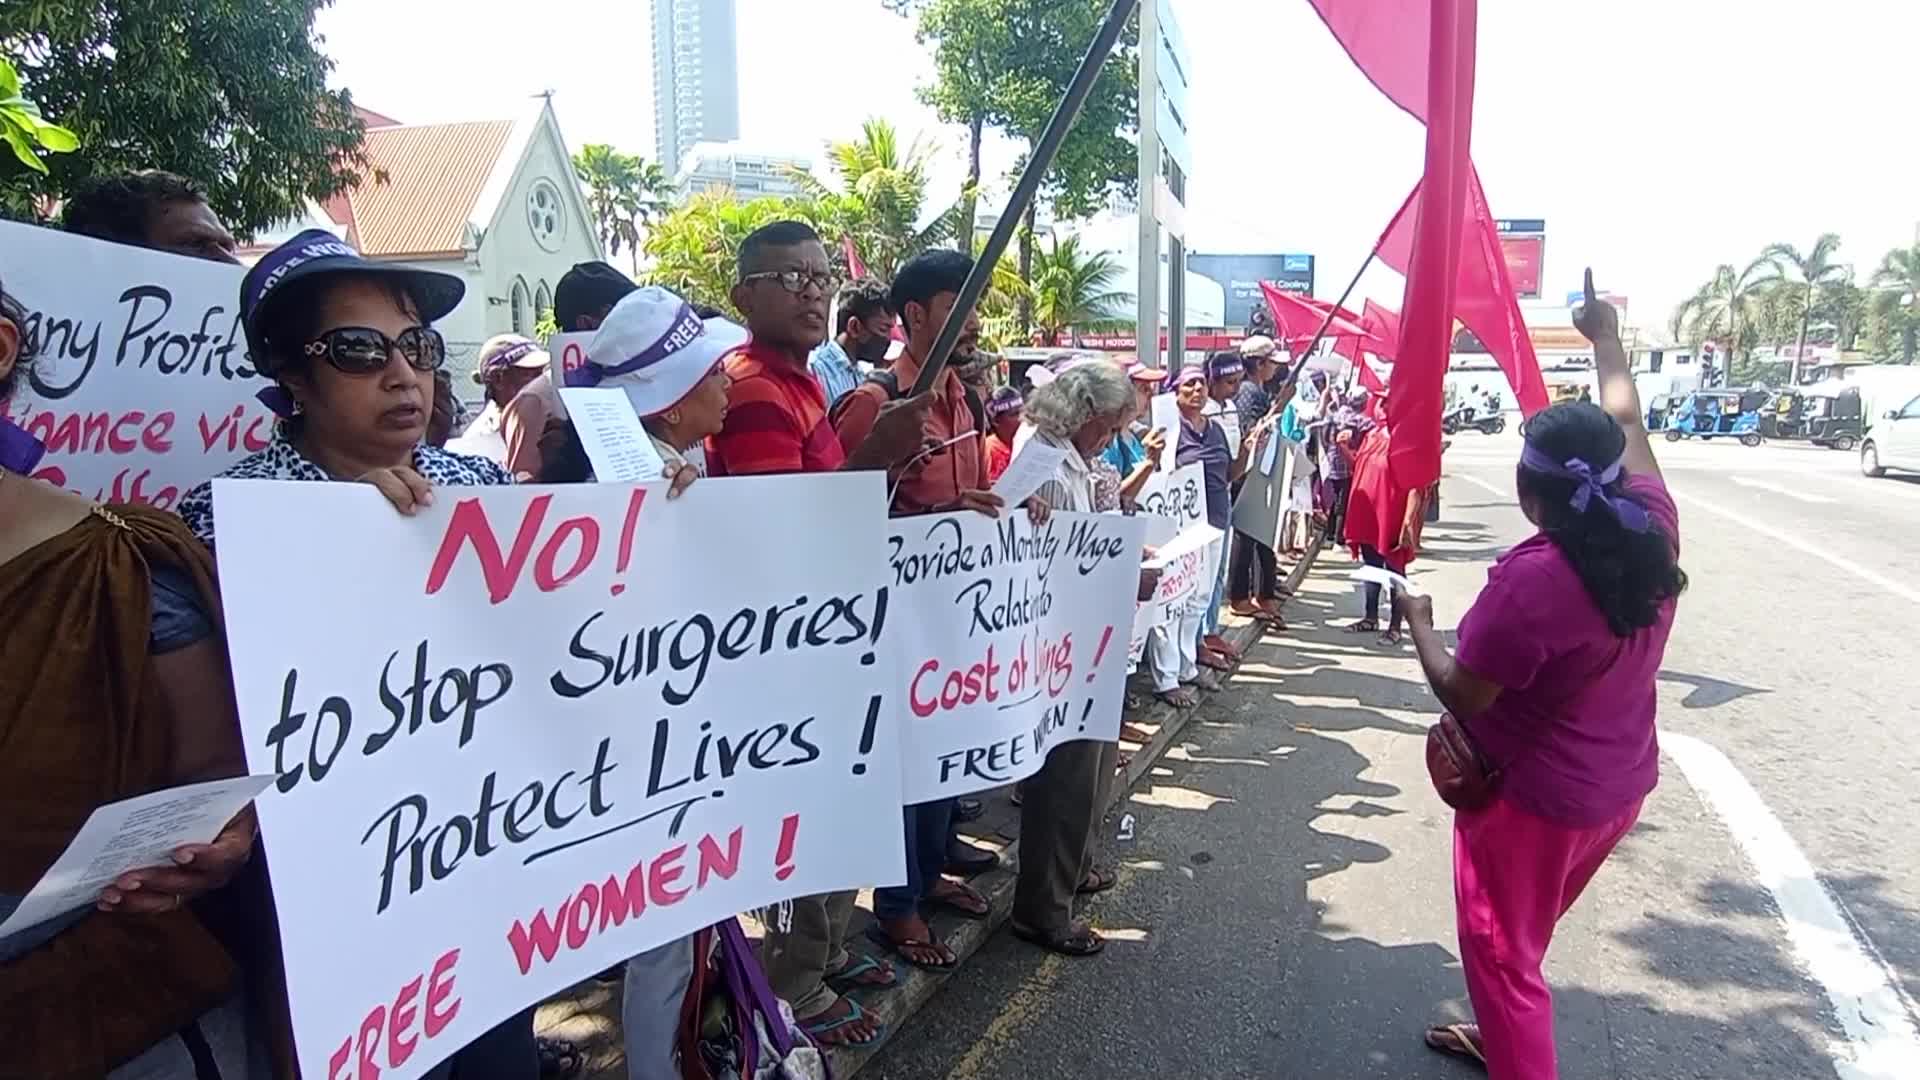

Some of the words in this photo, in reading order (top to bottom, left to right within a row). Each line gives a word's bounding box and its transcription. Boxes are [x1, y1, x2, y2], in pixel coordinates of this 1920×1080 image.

[663, 317, 699, 353] FREE
[1105, 338, 1137, 348] MOTORS
[426, 488, 647, 604] No!
[887, 518, 977, 588] Provide
[979, 543, 994, 570] a
[1063, 518, 1125, 577] Wage
[265, 668, 353, 794] to
[361, 640, 514, 757] Stop
[549, 585, 889, 706] Surgeries!
[910, 645, 1001, 718] Cost
[1007, 632, 1029, 691] of
[937, 734, 1026, 784] FREE
[360, 738, 619, 915] Protect
[645, 717, 823, 799] Lives
[327, 947, 463, 1080] FREE
[506, 824, 744, 977] WOMEN
